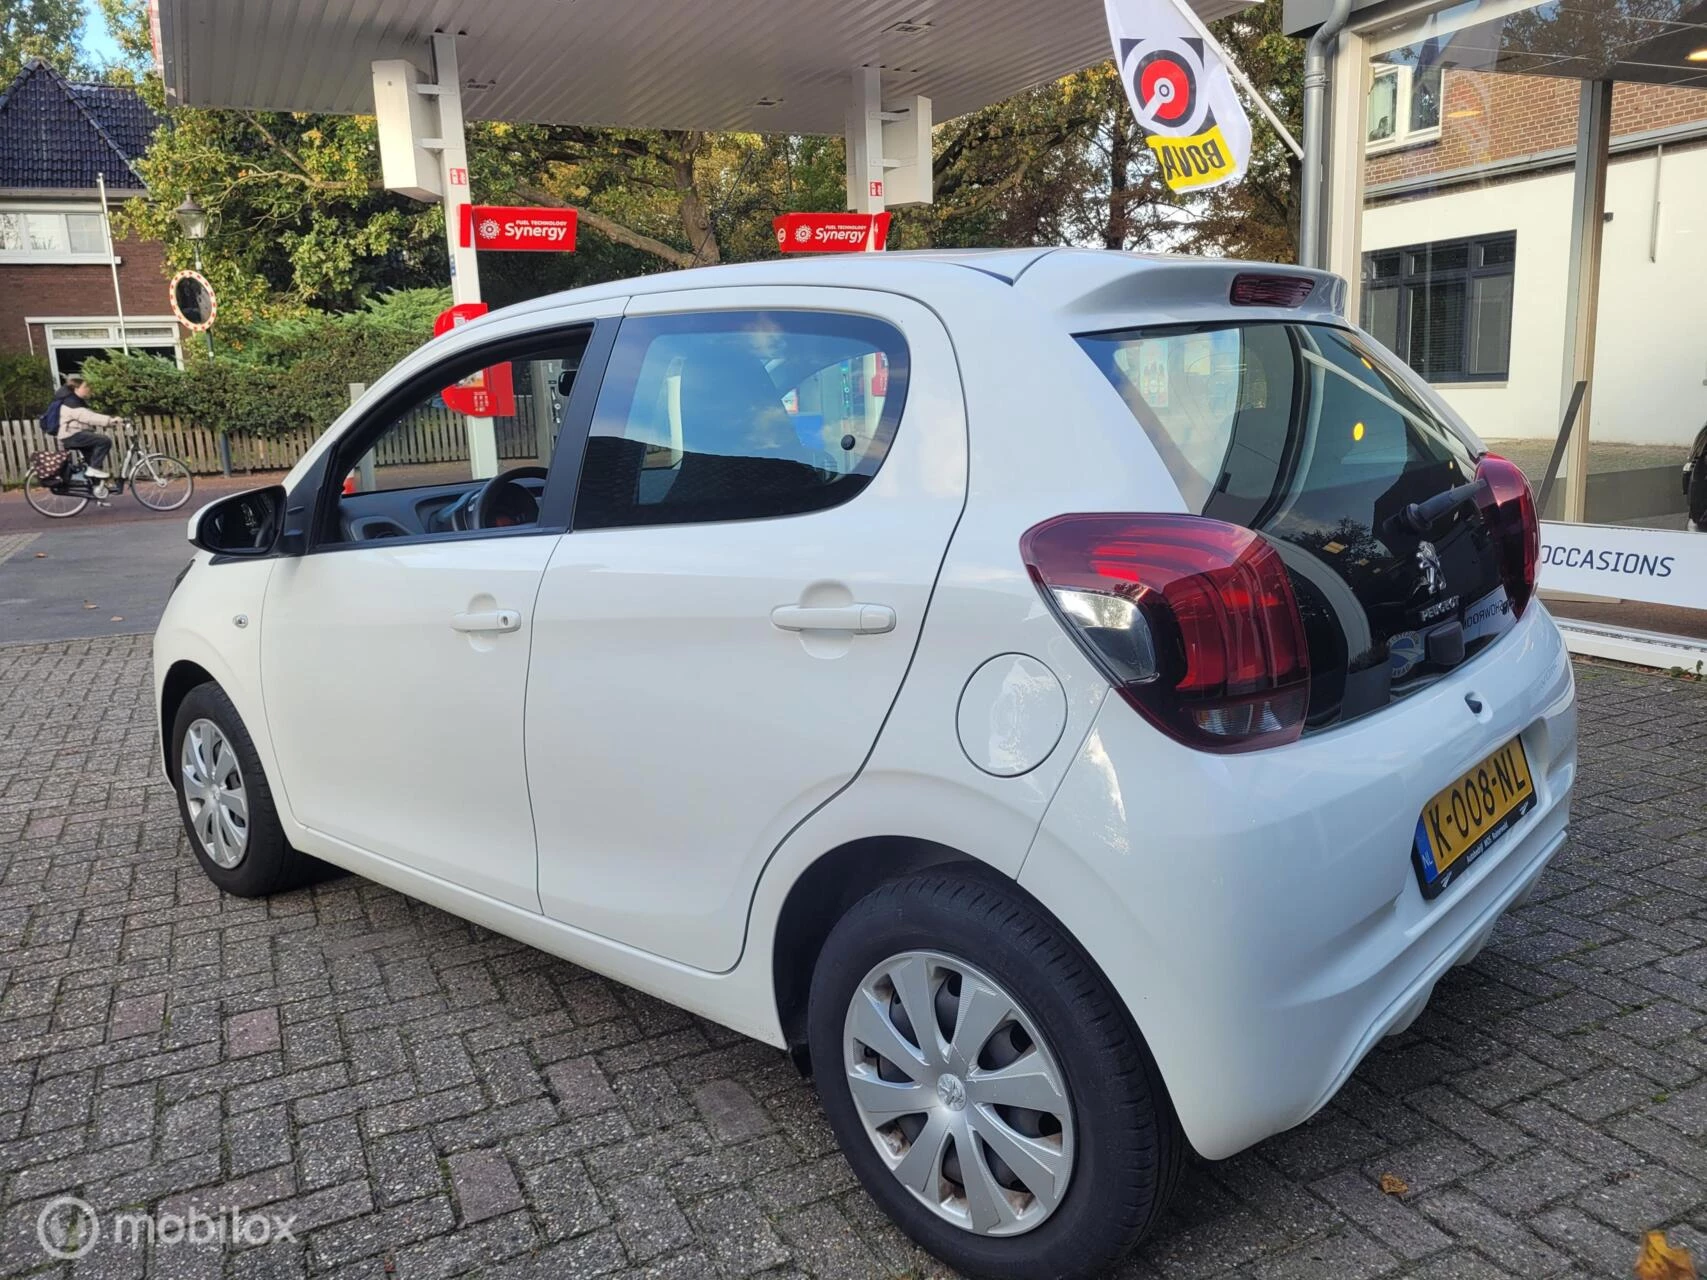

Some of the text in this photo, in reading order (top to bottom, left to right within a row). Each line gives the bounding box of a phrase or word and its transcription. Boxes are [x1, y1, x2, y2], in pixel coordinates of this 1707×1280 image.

[504, 222, 568, 241] Synergy
[814, 227, 867, 244] Synergy
[1541, 544, 1675, 578] OCCASIONS
[1420, 594, 1460, 622] PEUGEOT
[1428, 747, 1527, 859] K-008-NL
